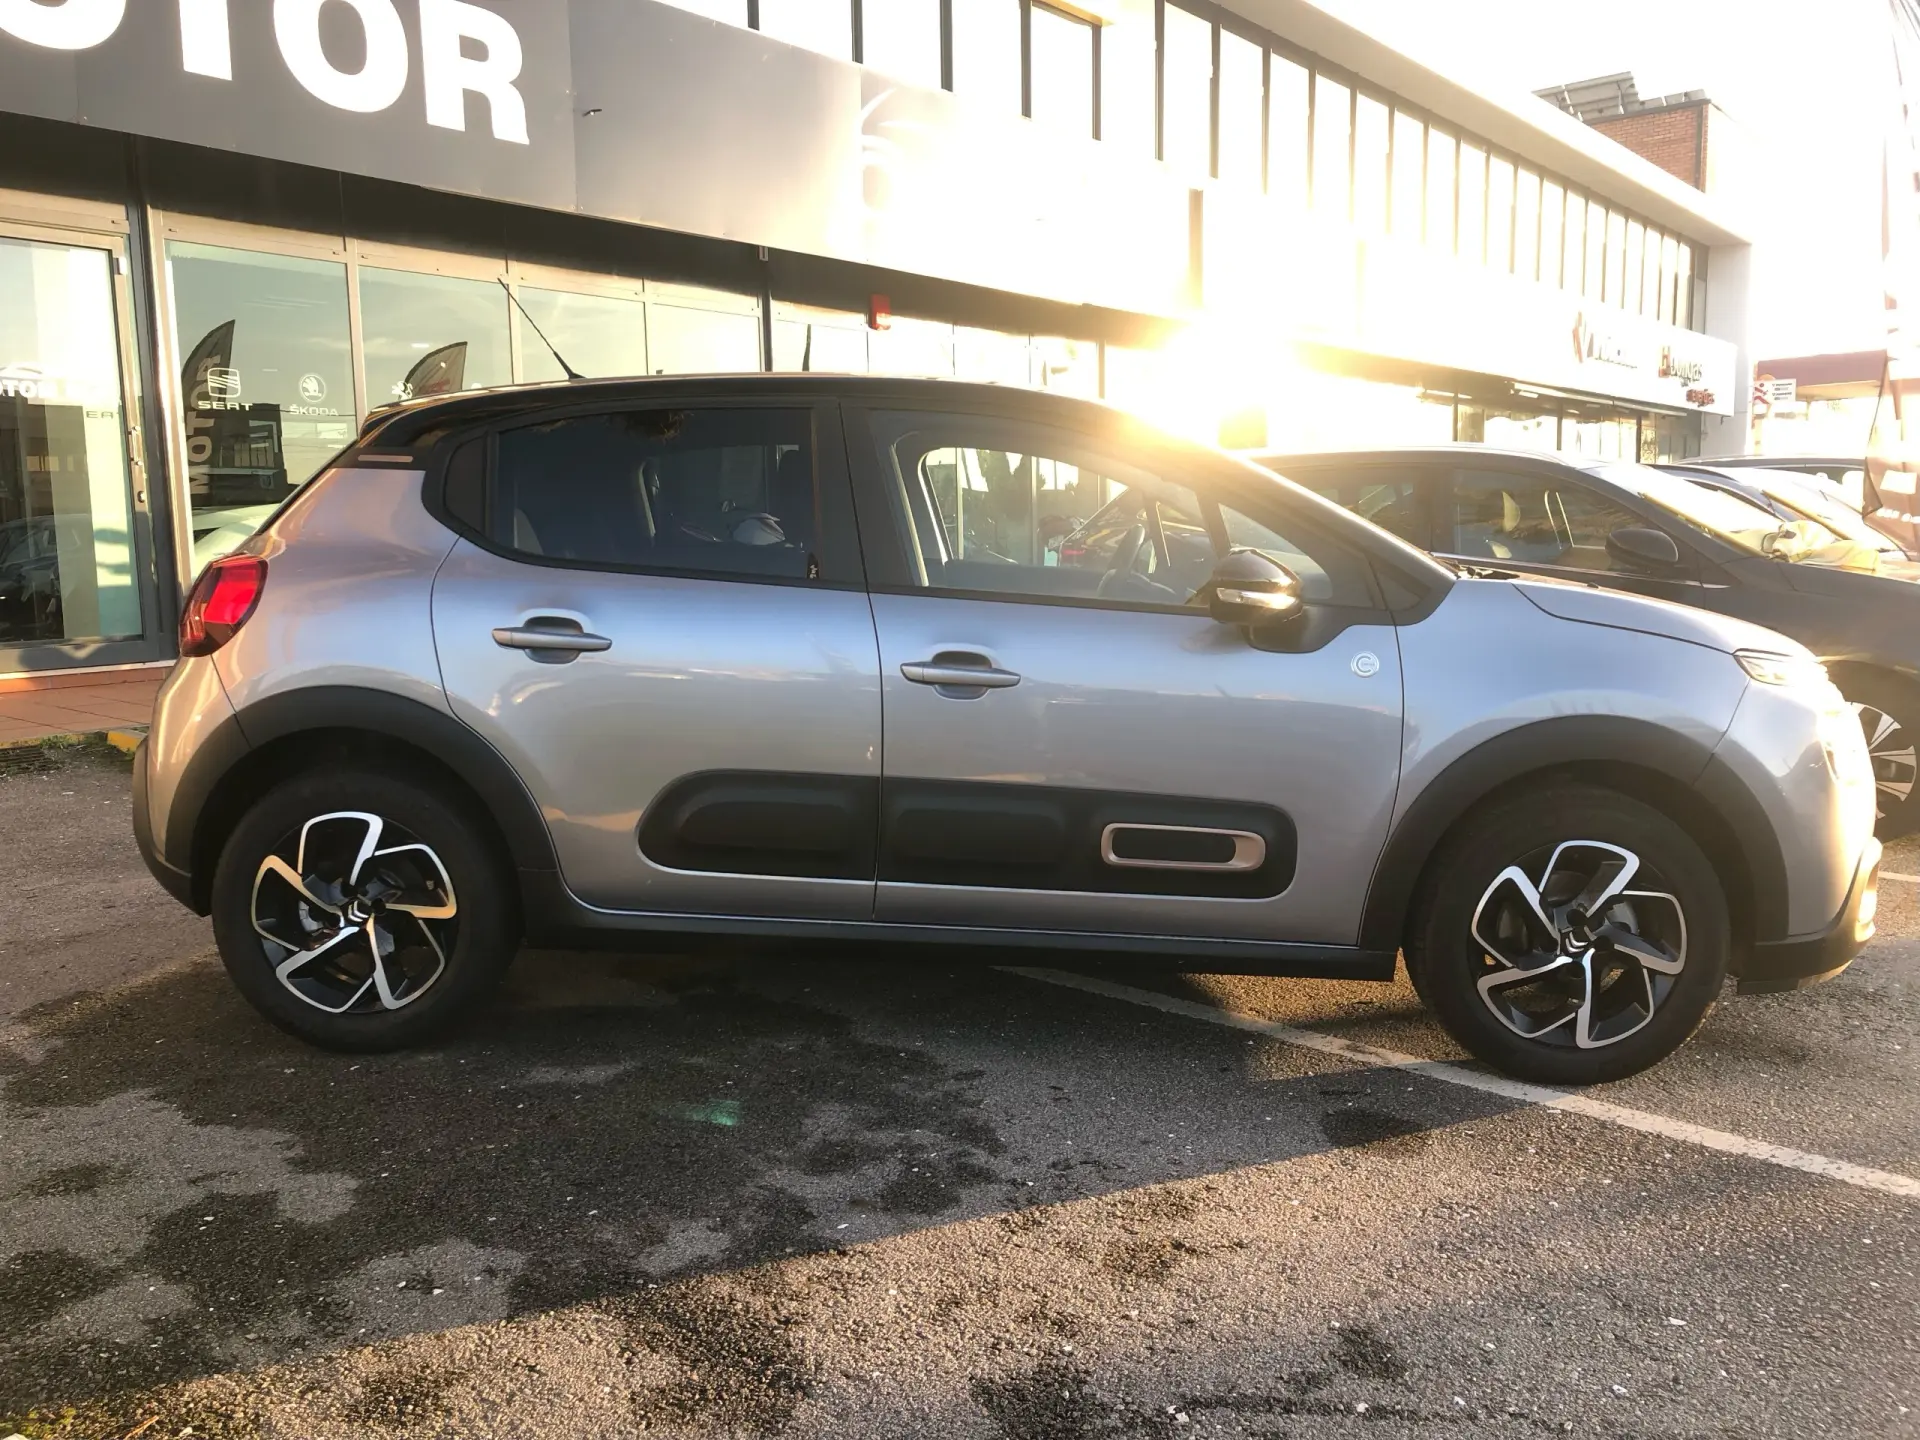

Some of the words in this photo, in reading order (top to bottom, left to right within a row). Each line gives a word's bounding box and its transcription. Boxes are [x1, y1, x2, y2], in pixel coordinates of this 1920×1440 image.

[197, 400, 253, 411] SEAT
[289, 404, 339, 416] ŠKODA
[86, 410, 119, 419] EA
[186, 354, 221, 494] MOTOR
